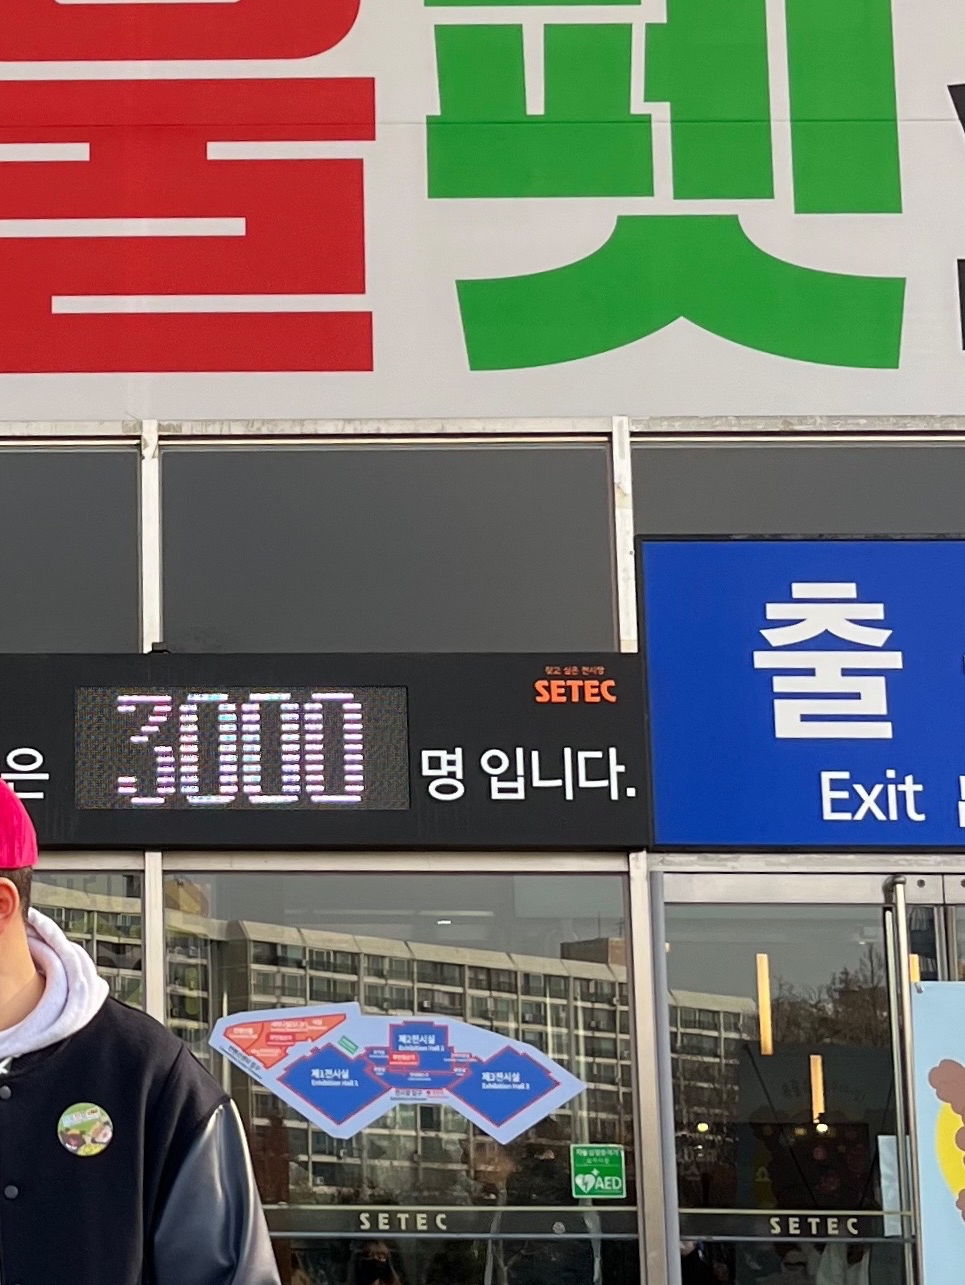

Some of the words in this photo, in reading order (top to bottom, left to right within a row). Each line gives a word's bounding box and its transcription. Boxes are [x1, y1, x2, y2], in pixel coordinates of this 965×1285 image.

[753, 581, 905, 739] 출
[534, 679, 617, 703] SETEC
[117, 692, 364, 804] 3000
[421, 747, 464, 801] 명
[480, 746, 637, 801] 입니다.
[820, 769, 926, 821] Exit
[595, 1176, 622, 1190] AED
[360, 1212, 448, 1231] SETEC
[769, 1217, 859, 1235] SETEC
